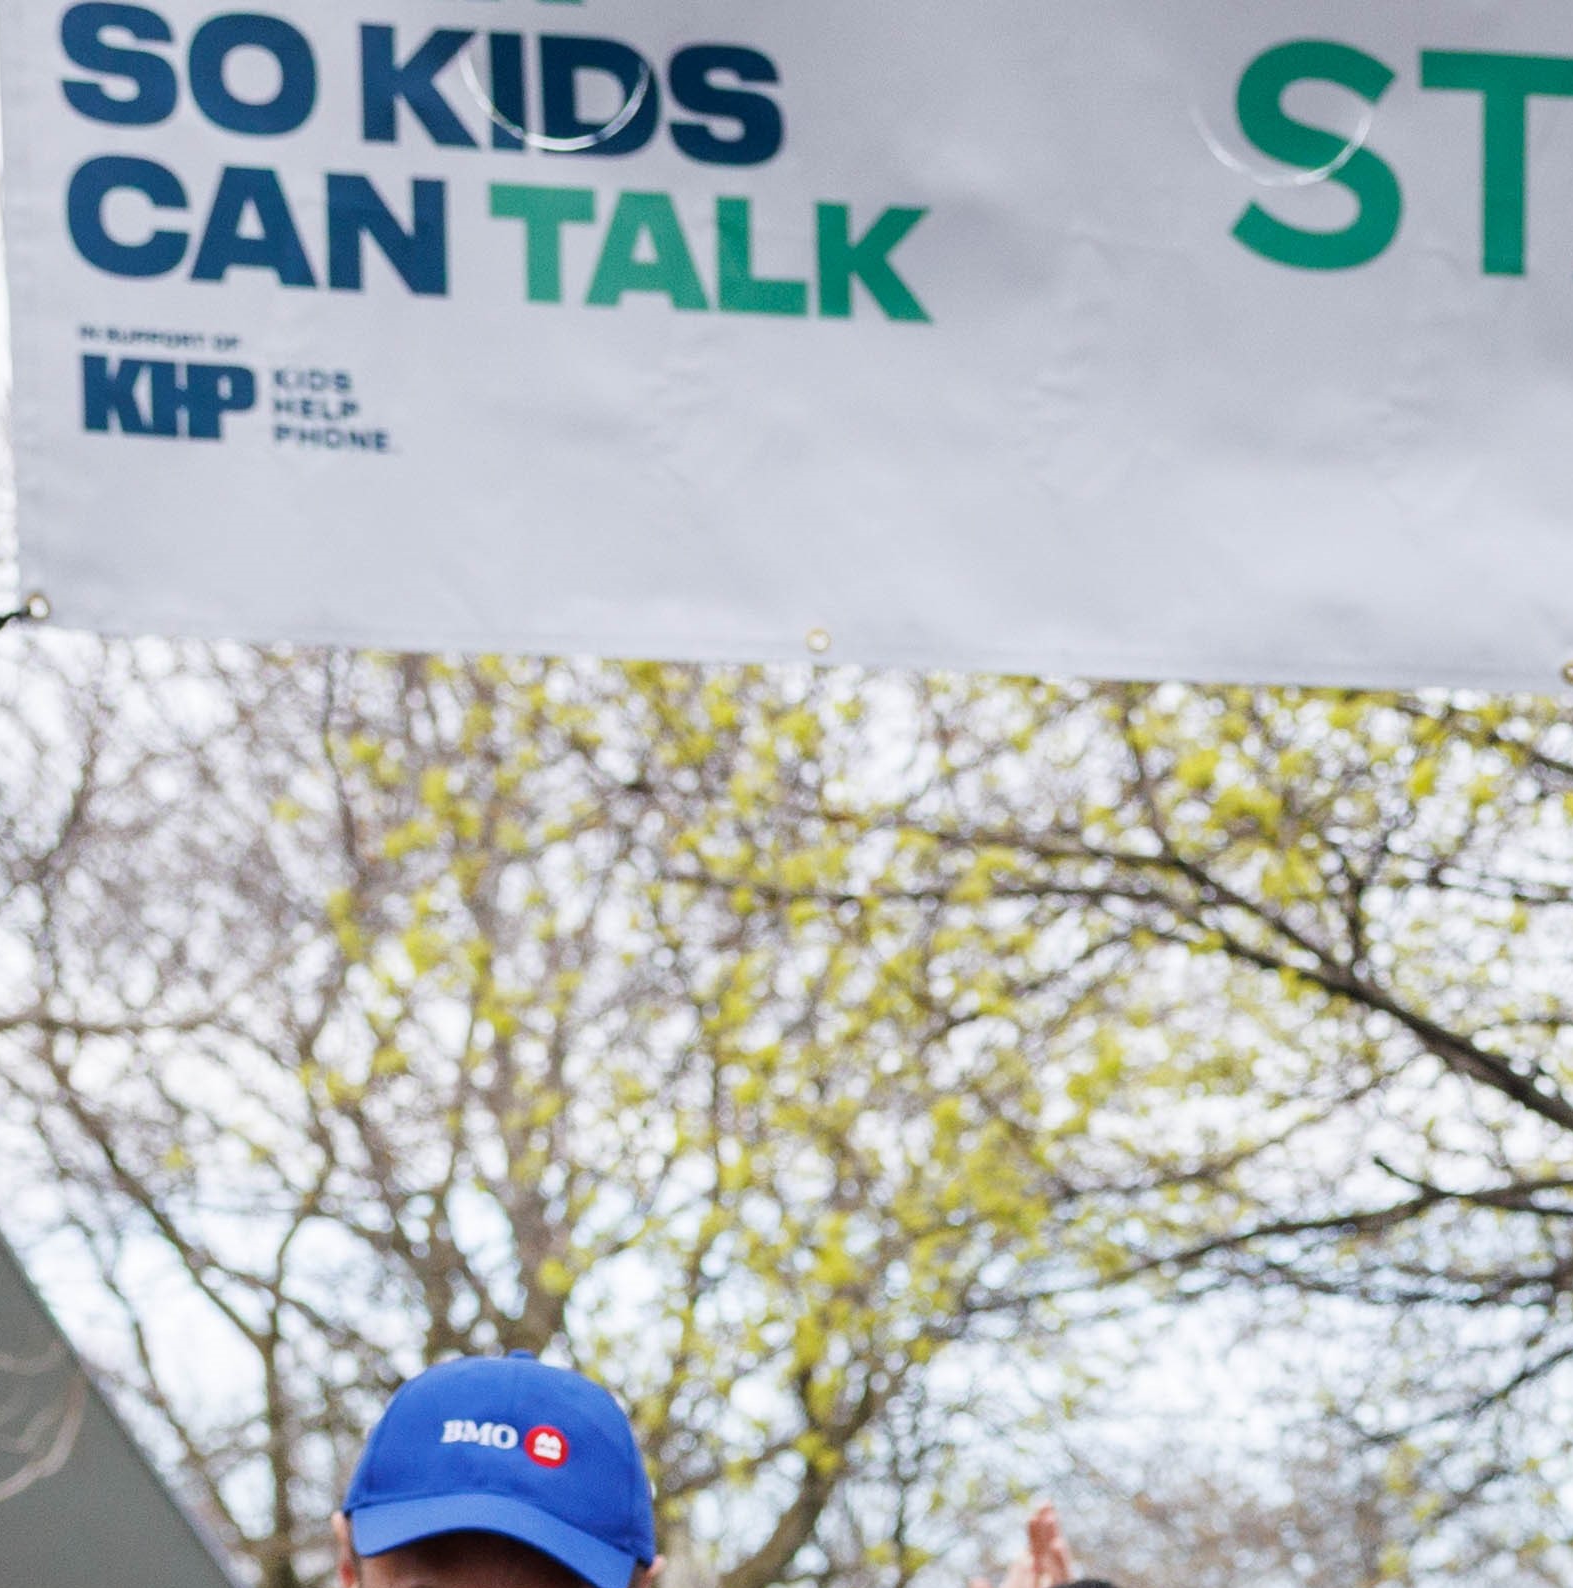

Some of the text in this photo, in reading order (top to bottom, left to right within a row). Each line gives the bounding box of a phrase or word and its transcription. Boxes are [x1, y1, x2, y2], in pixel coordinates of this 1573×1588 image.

[59, 0, 788, 169] SO KIDS
[65, 154, 933, 325] CAN TALK
[273, 367, 353, 392] KIDS
[82, 353, 255, 440] KHP
[273, 397, 359, 420] HELP
[273, 424, 389, 453] PHONE
[439, 1419, 519, 1450] BMO
